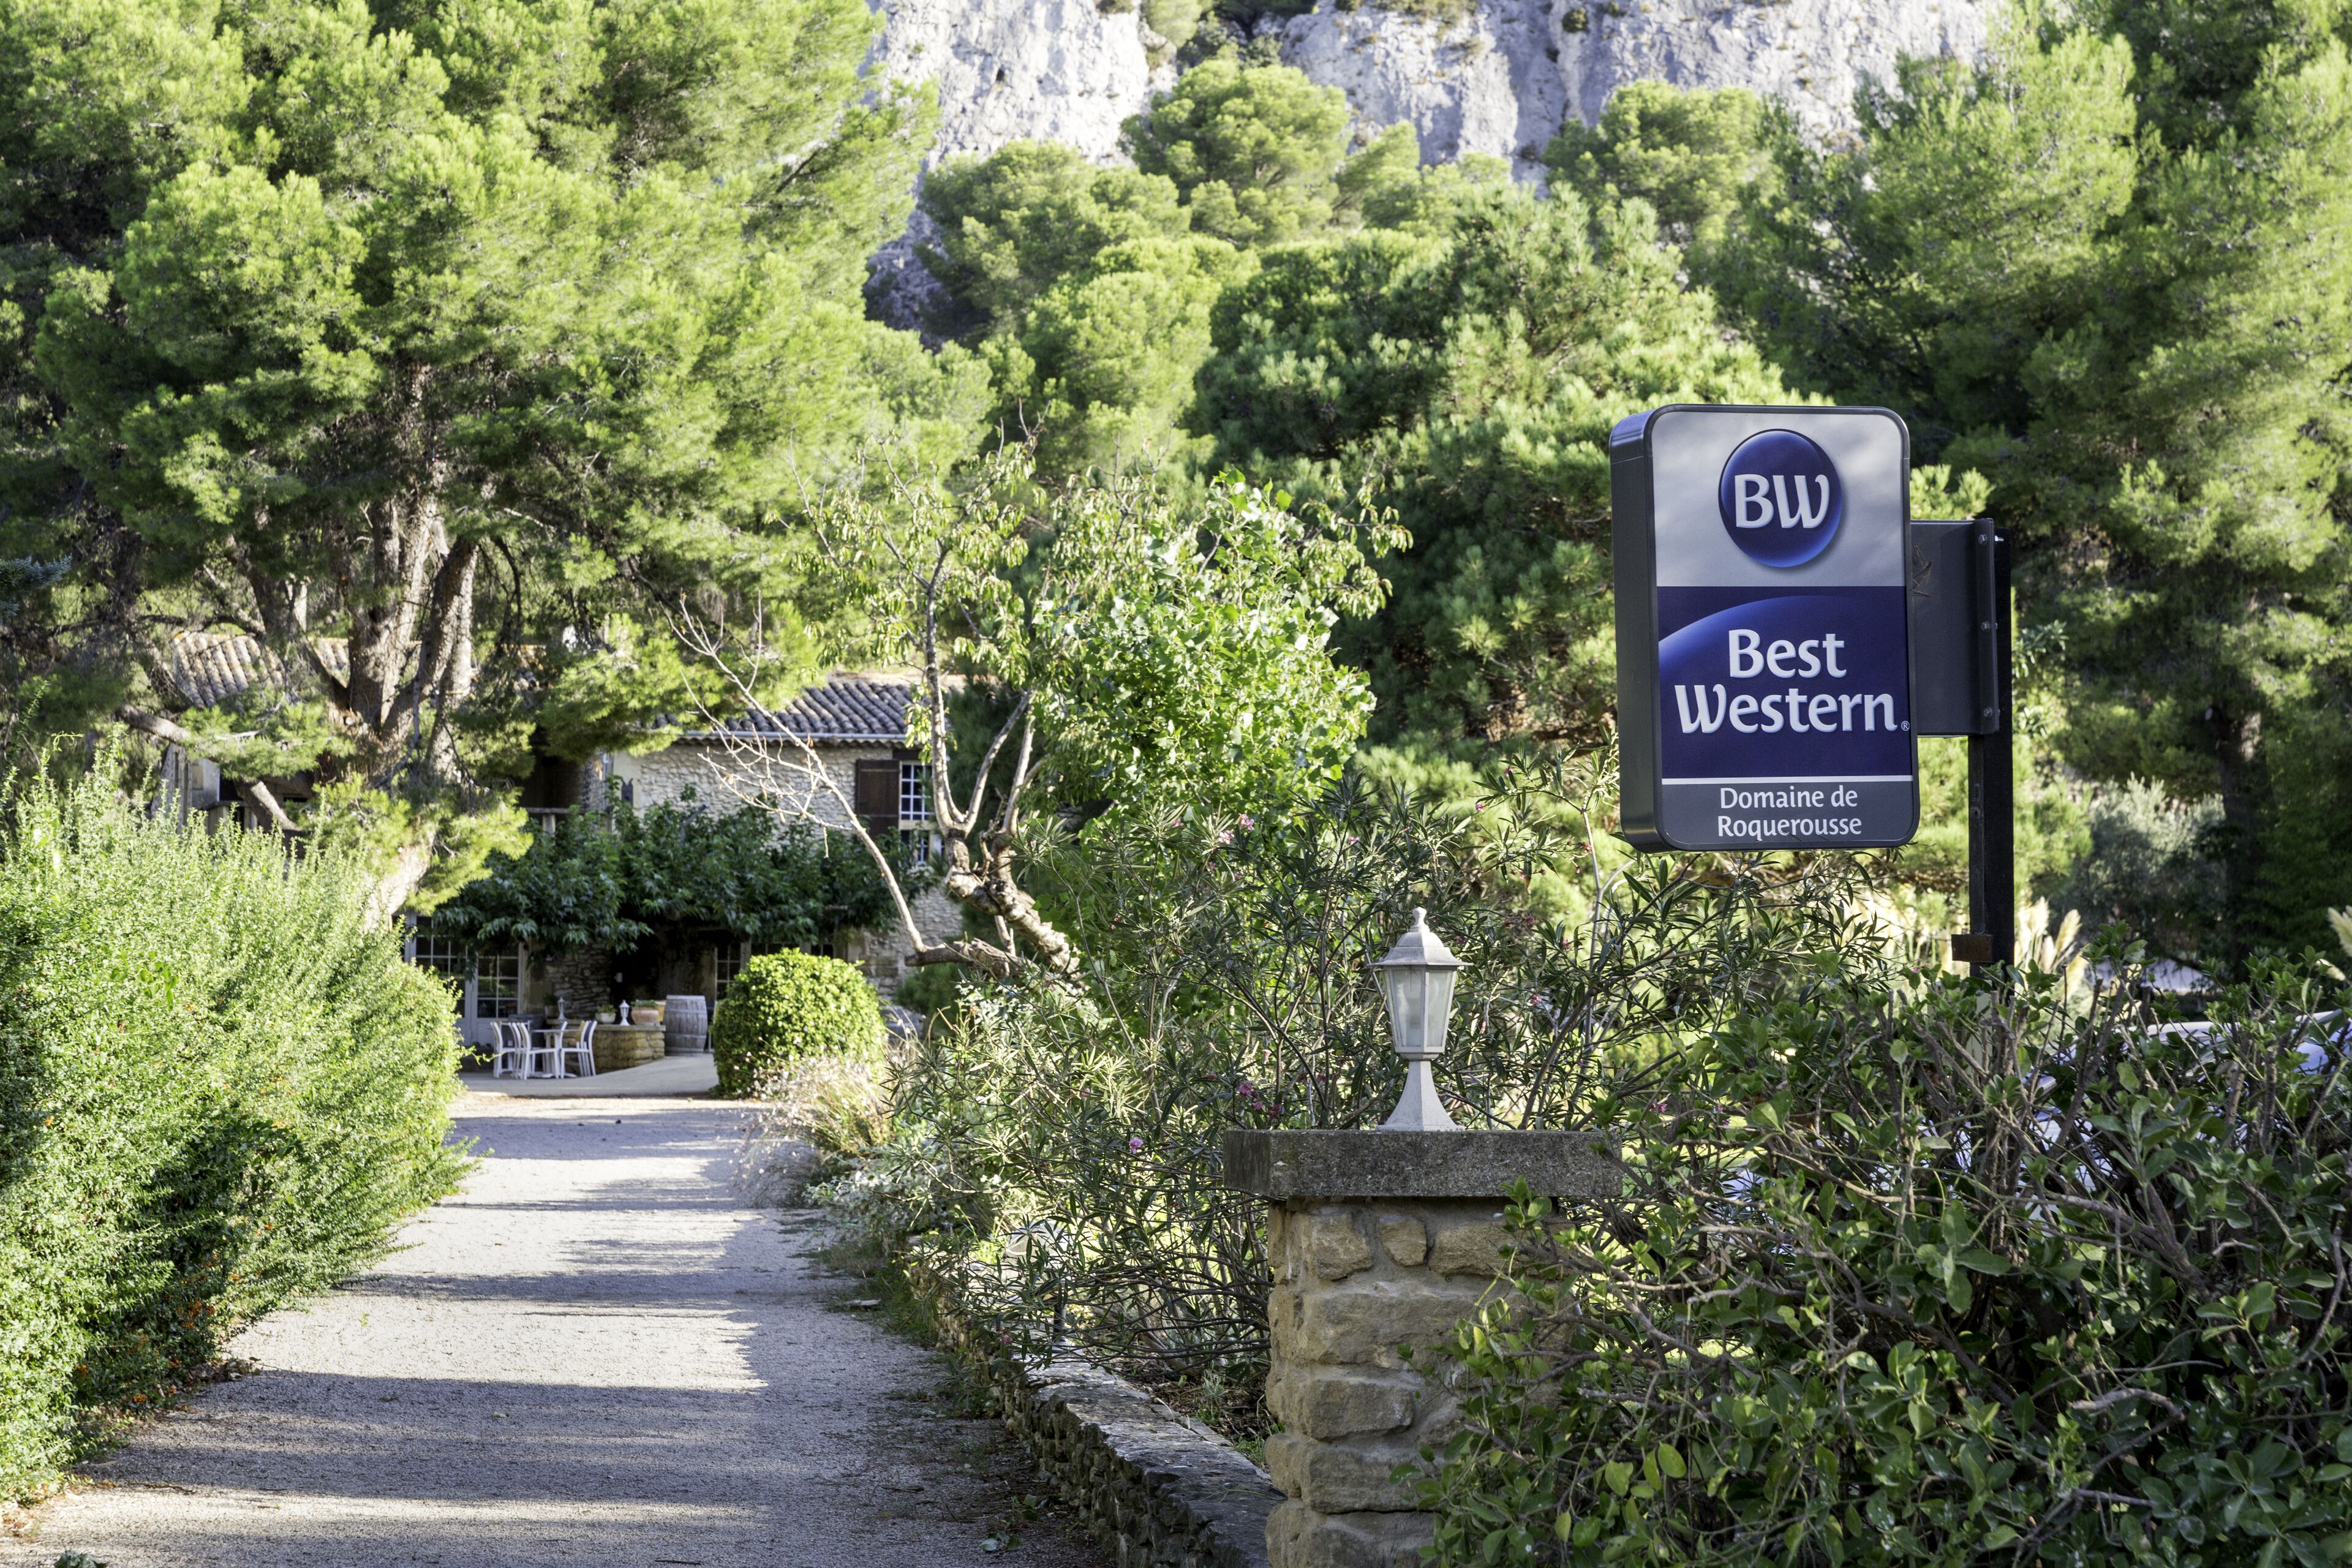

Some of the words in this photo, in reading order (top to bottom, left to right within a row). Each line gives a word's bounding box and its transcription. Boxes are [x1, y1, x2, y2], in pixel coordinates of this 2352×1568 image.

[1734, 473, 1830, 529] BW
[1728, 629, 1847, 679] Best
[1719, 785, 1825, 809] Domaine
[1830, 785, 1858, 808] de
[1717, 815, 1862, 842] Roquerousse
